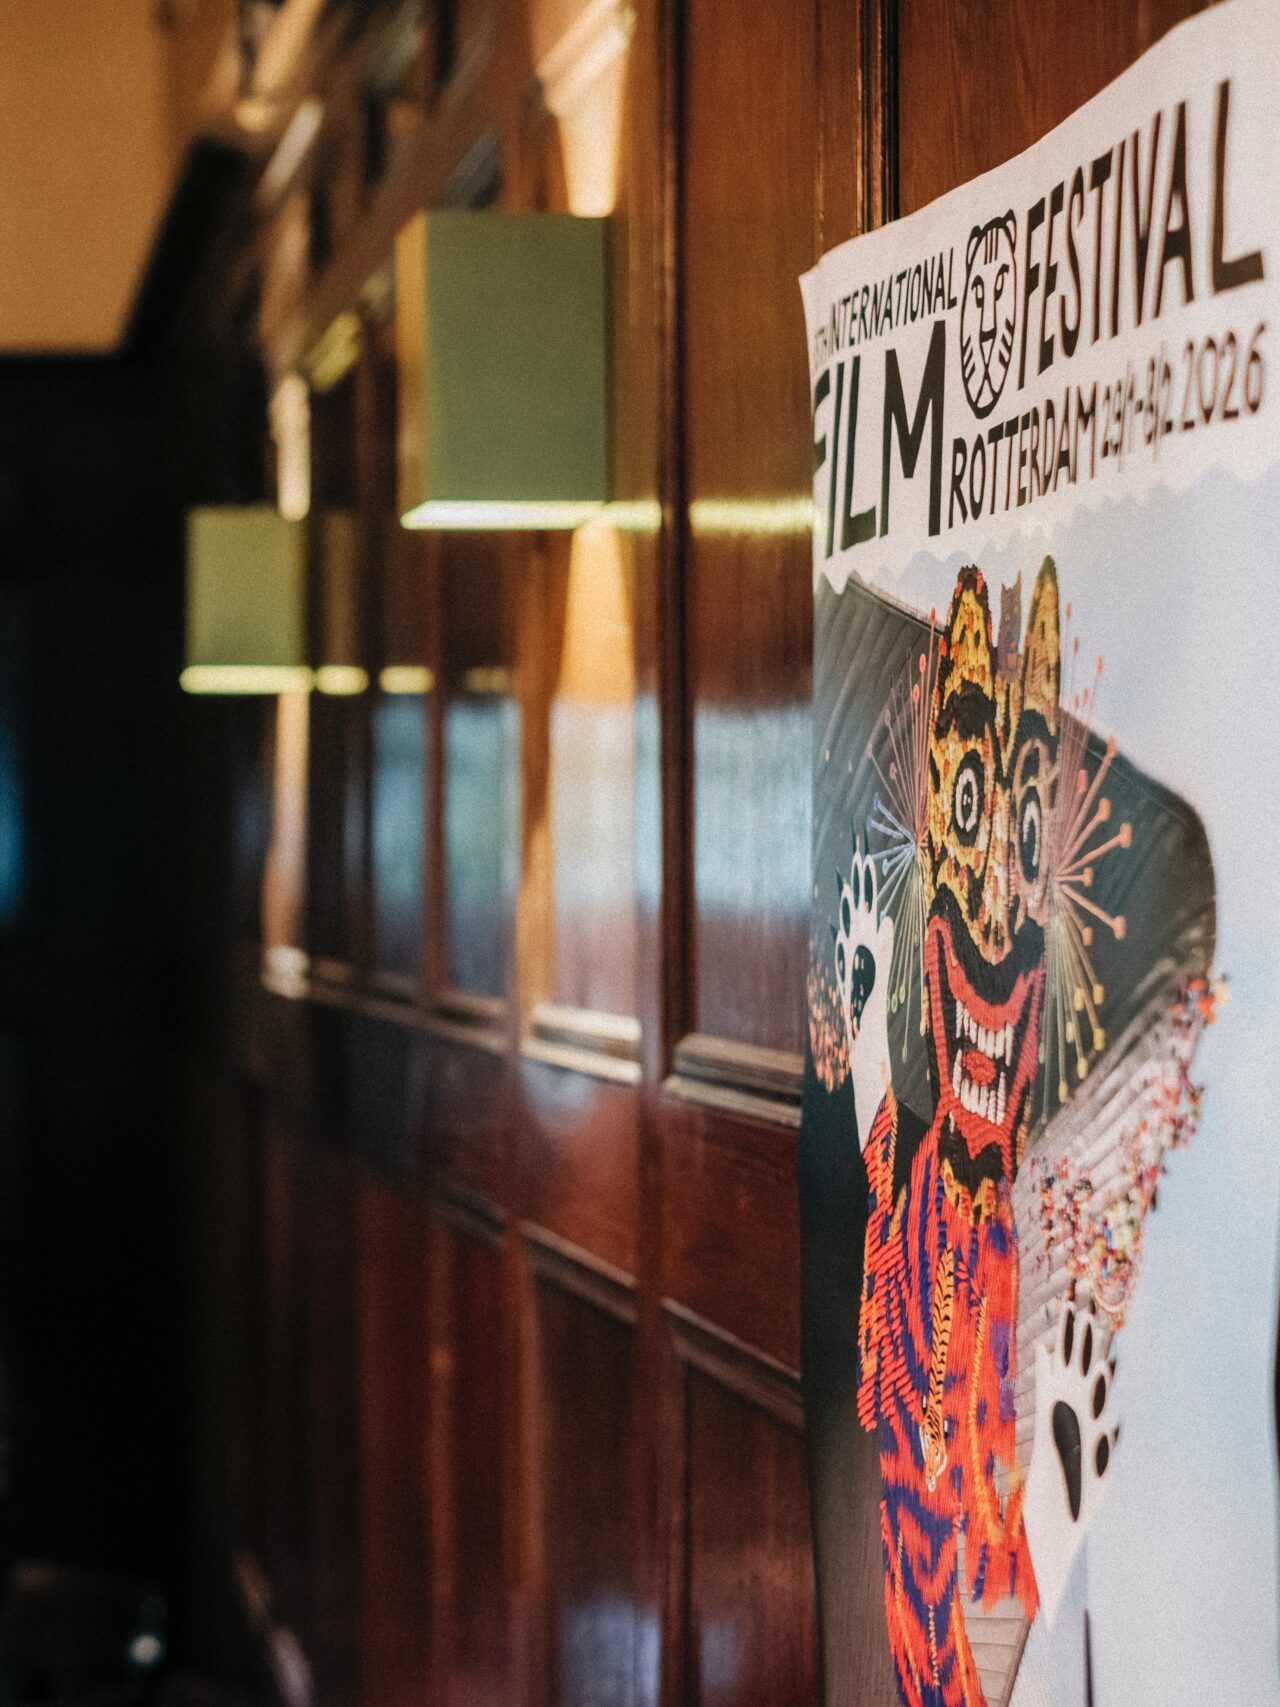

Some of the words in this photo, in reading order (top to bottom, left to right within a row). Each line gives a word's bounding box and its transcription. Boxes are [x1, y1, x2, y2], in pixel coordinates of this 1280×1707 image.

[829, 247, 958, 356] INTERNATIONAL
[1018, 79, 1265, 391] FESTIVAL
[948, 380, 1097, 530] ROTTERDAM
[1180, 322, 1266, 433] 2026
